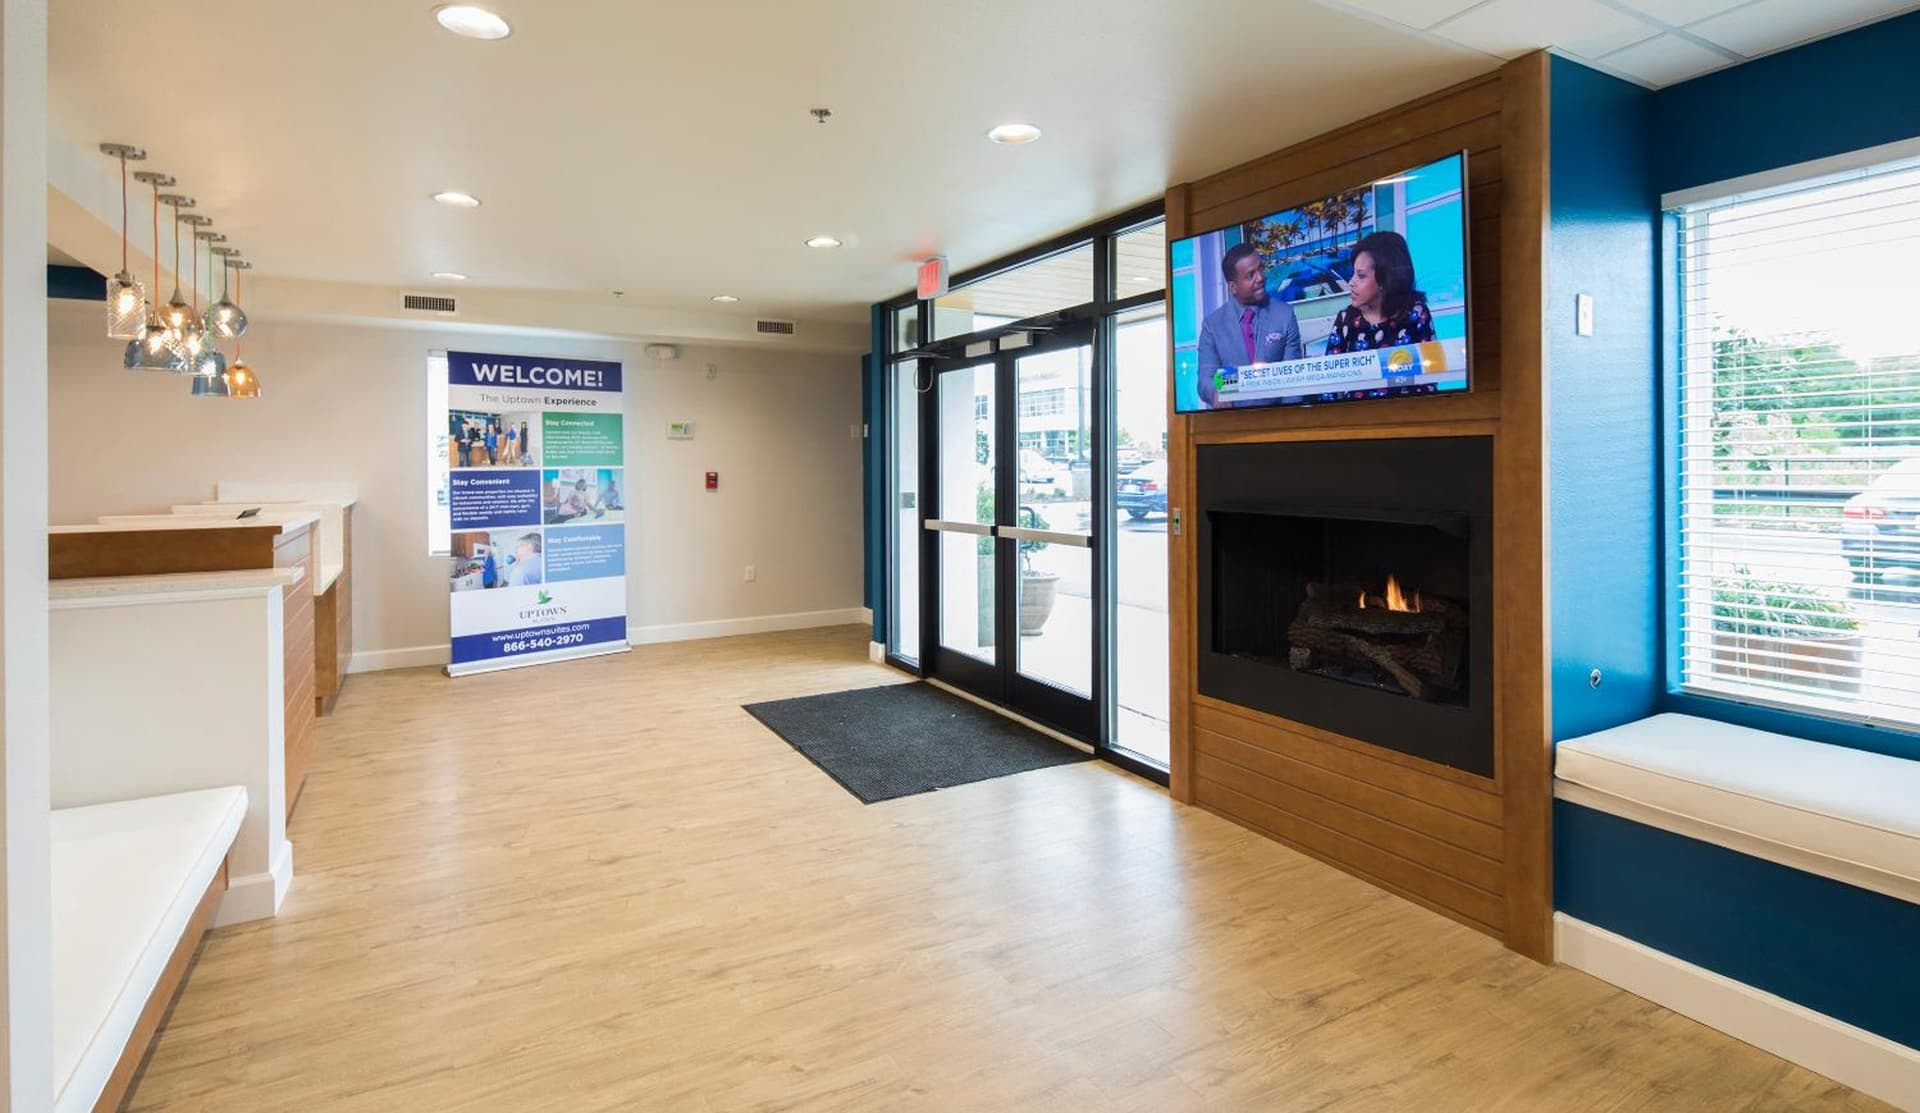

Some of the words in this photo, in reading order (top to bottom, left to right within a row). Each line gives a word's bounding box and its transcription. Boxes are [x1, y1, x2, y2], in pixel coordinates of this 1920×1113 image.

[471, 362, 604, 387] WELCOME!
[1272, 364, 1293, 376] LIVES
[1294, 363, 1306, 373] OF
[1306, 361, 1322, 371] THE
[1324, 357, 1352, 370] SUPER
[480, 393, 500, 402] The
[501, 394, 542, 405] Uptown
[544, 396, 597, 407] Experience
[560, 419, 595, 427] Connected
[452, 479, 469, 487] Stay
[470, 478, 511, 487] Convenient
[519, 606, 568, 620] UPTOWN
[492, 622, 590, 642] www.uptownsuites.com
[503, 632, 584, 653] 866-540-2970
